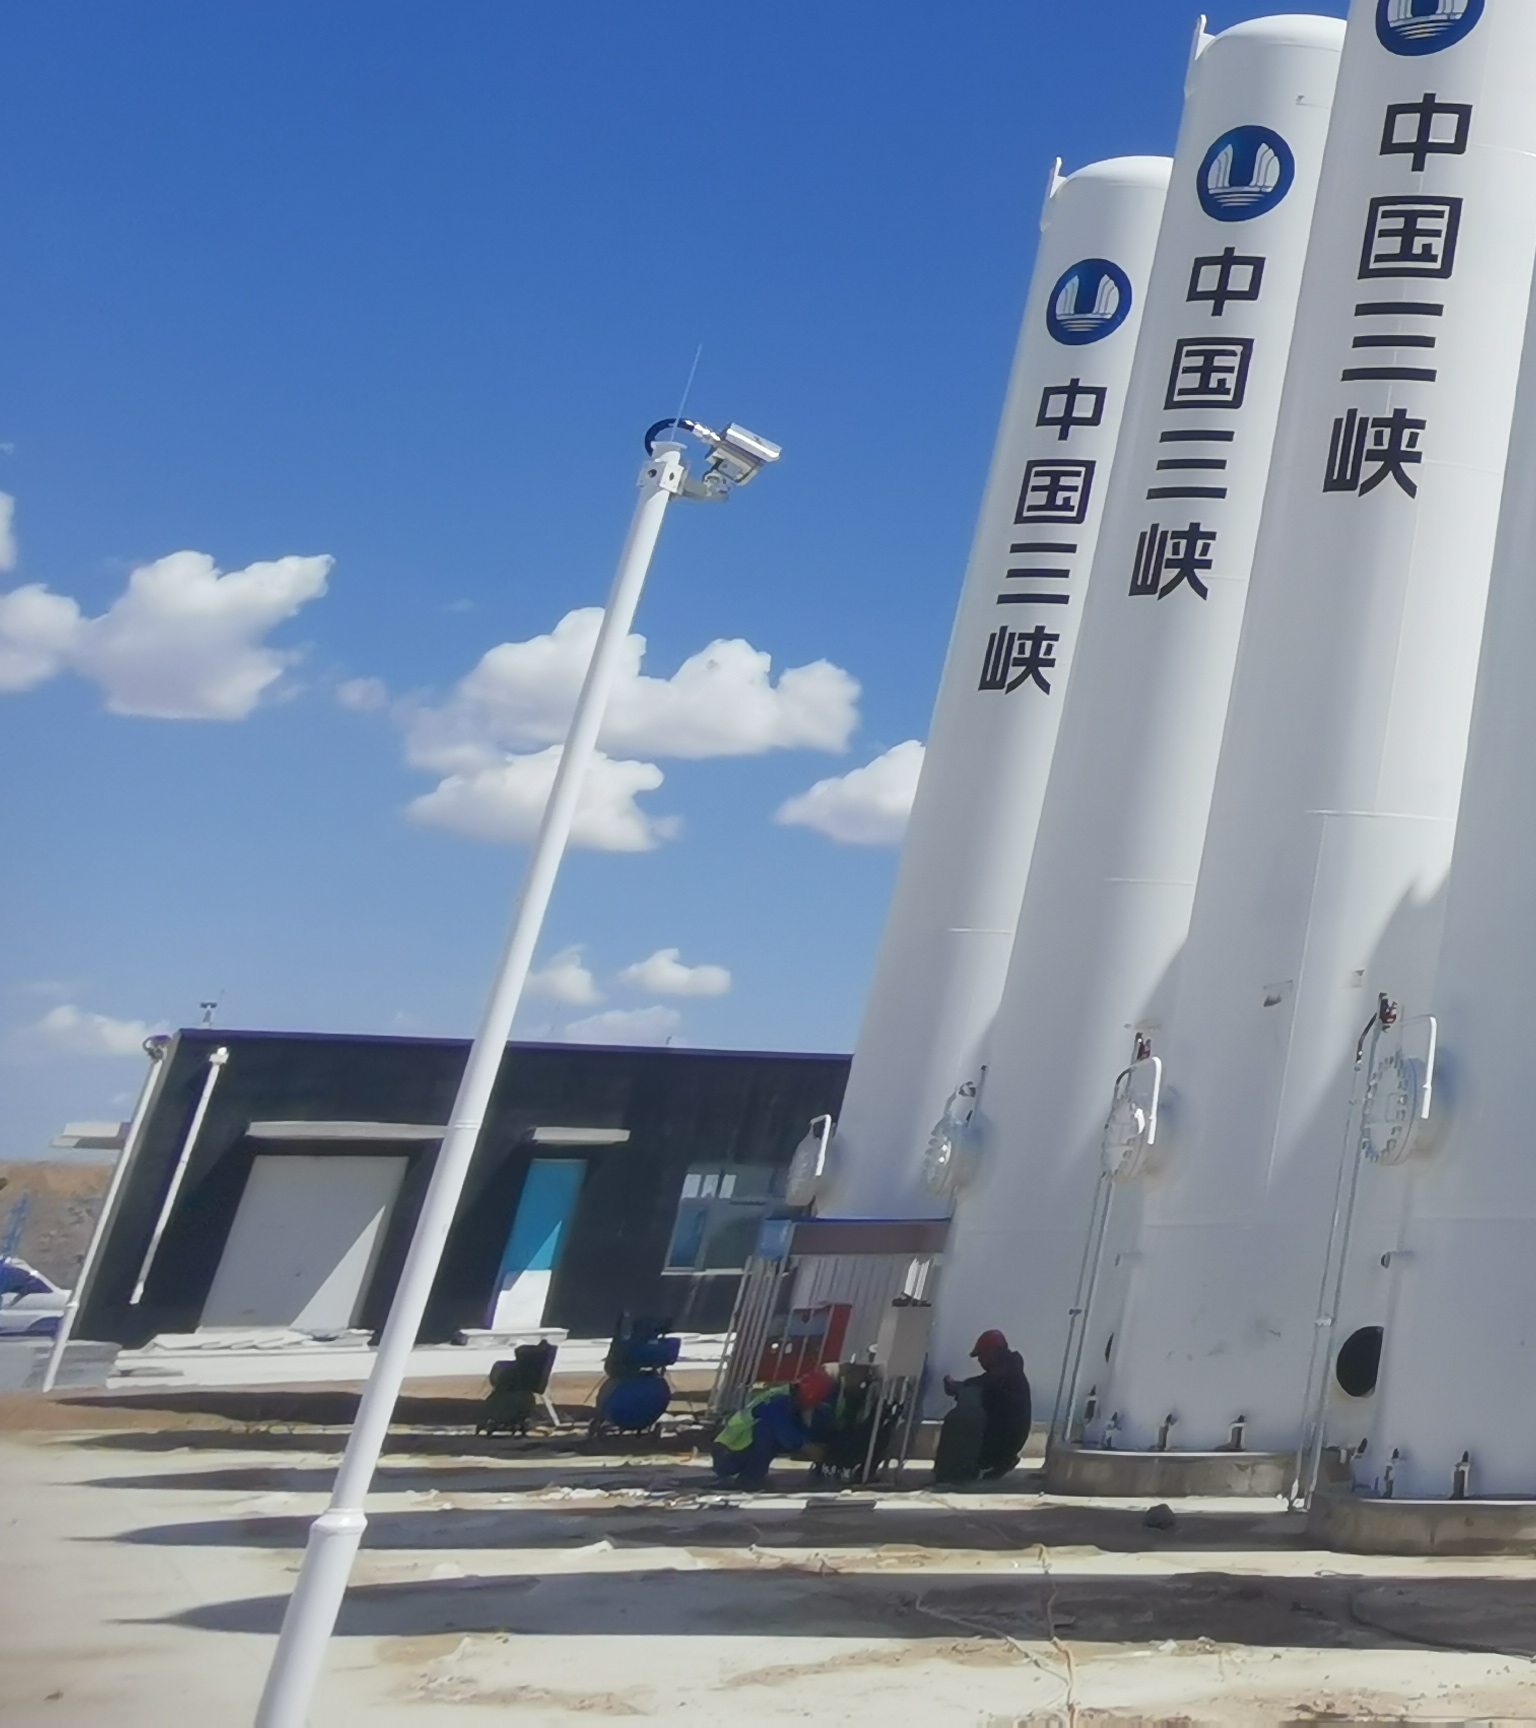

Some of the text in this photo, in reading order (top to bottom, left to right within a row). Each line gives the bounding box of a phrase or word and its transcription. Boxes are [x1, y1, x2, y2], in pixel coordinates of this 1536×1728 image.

[1128, 246, 1266, 601] 中国三峡
[1322, 92, 1473, 499] 中国三峡
[978, 377, 1107, 695] 中国三峡
